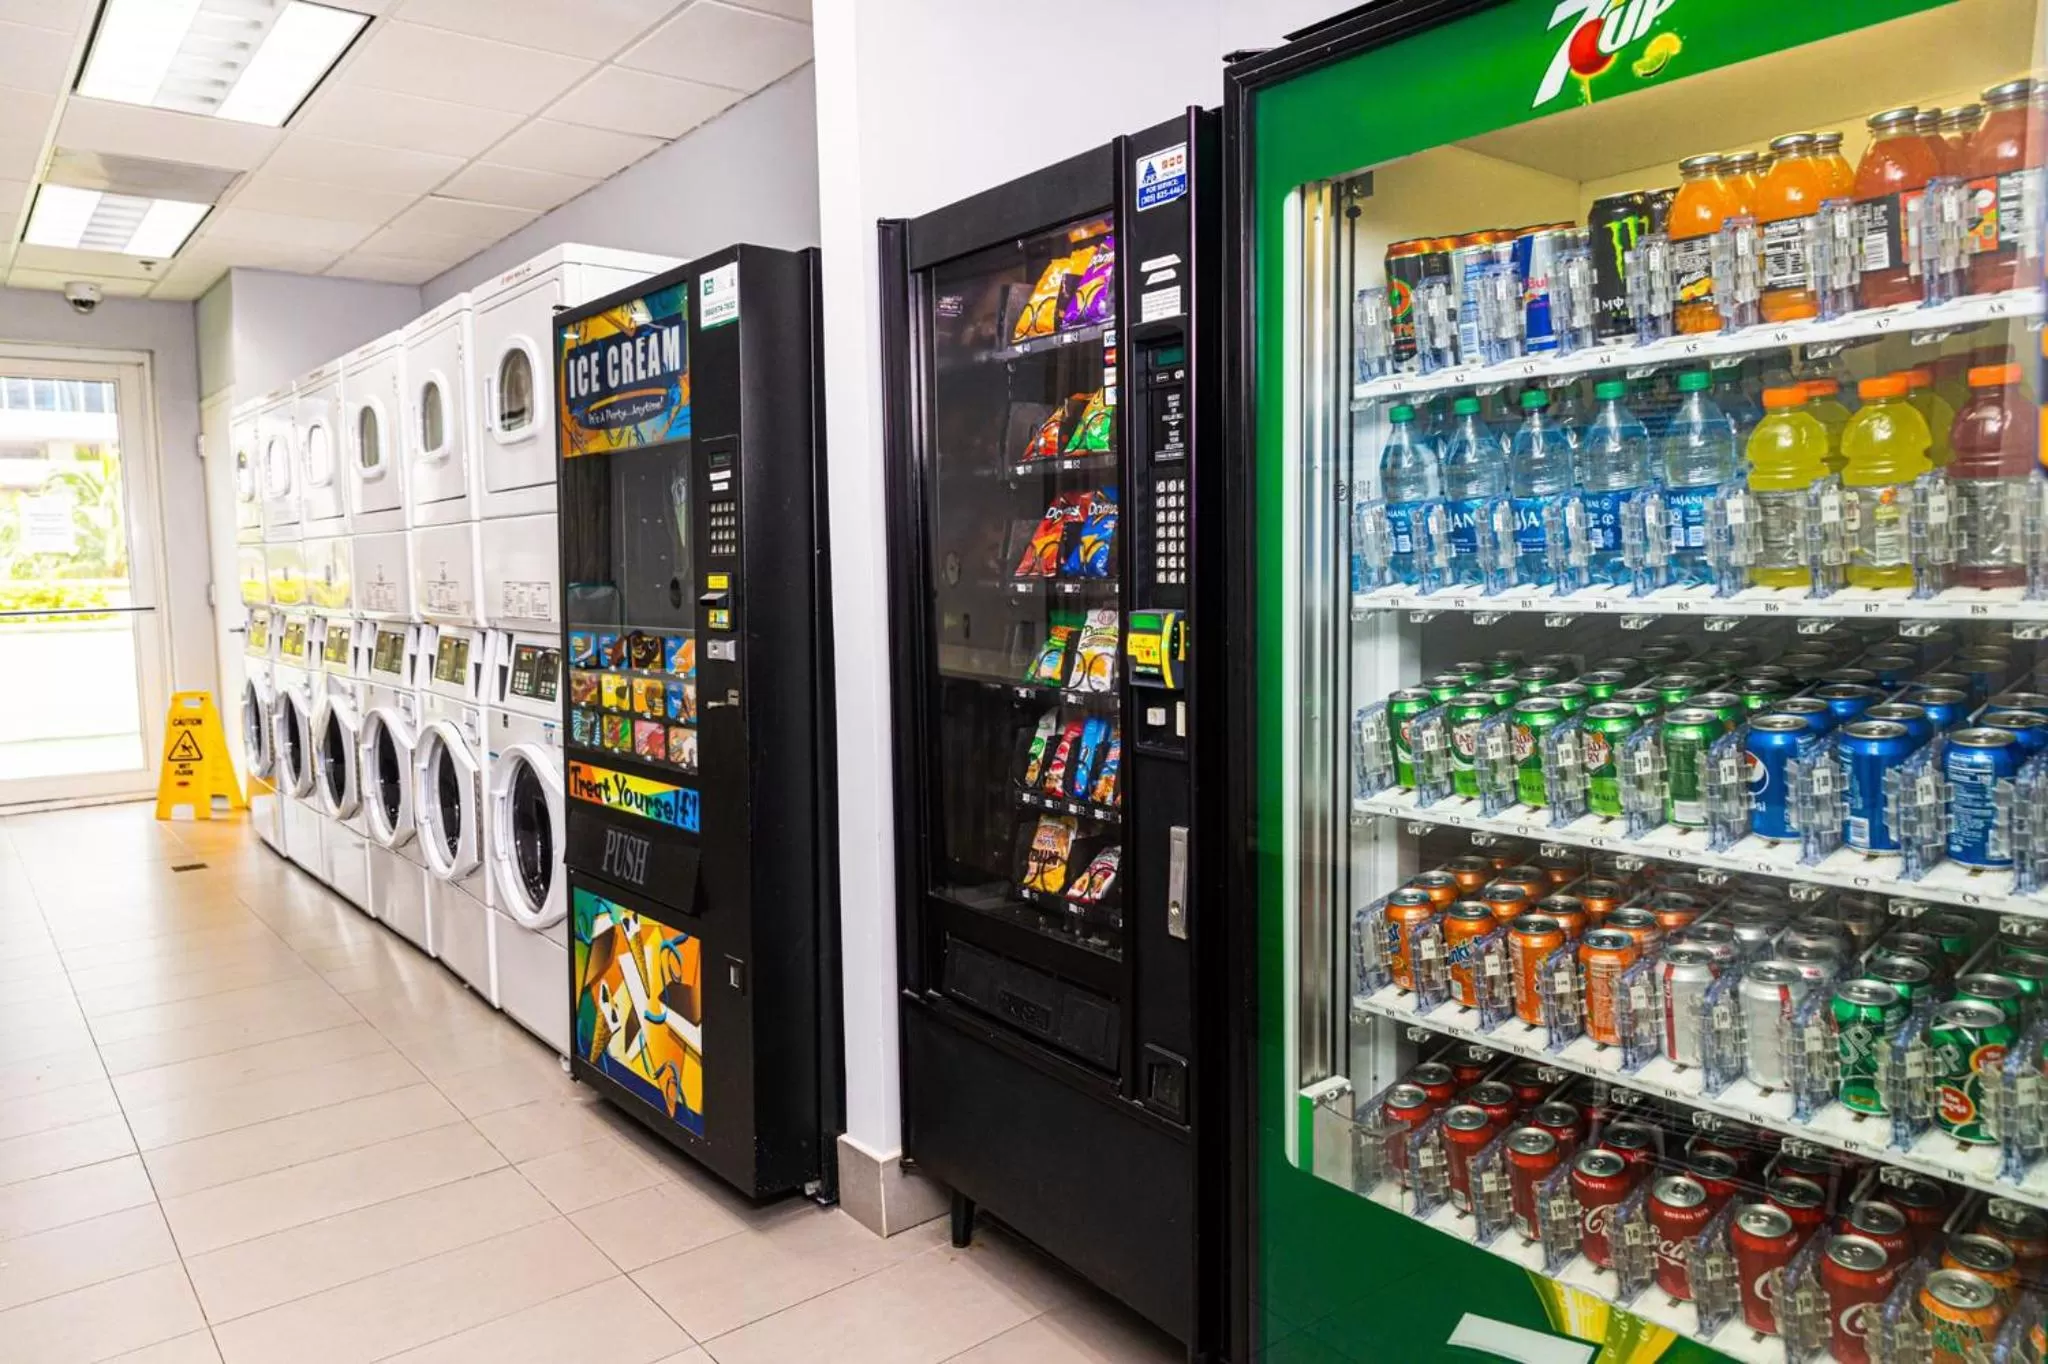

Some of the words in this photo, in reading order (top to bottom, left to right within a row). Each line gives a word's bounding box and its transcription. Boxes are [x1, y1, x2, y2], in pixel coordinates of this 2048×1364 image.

[1874, 318, 1891, 329] A7
[569, 351, 600, 399] ICE
[607, 325, 681, 387] CREAM
[1454, 373, 1464, 383] A2
[1454, 600, 1464, 608] B2
[1765, 603, 1779, 612] B6
[1864, 604, 1880, 613] B7
[172, 718, 202, 727] CAUTION
[571, 766, 611, 802] Treat
[613, 773, 698, 828] Yourself!
[1517, 826, 1528, 835] C3
[601, 828, 650, 885] PUSH
